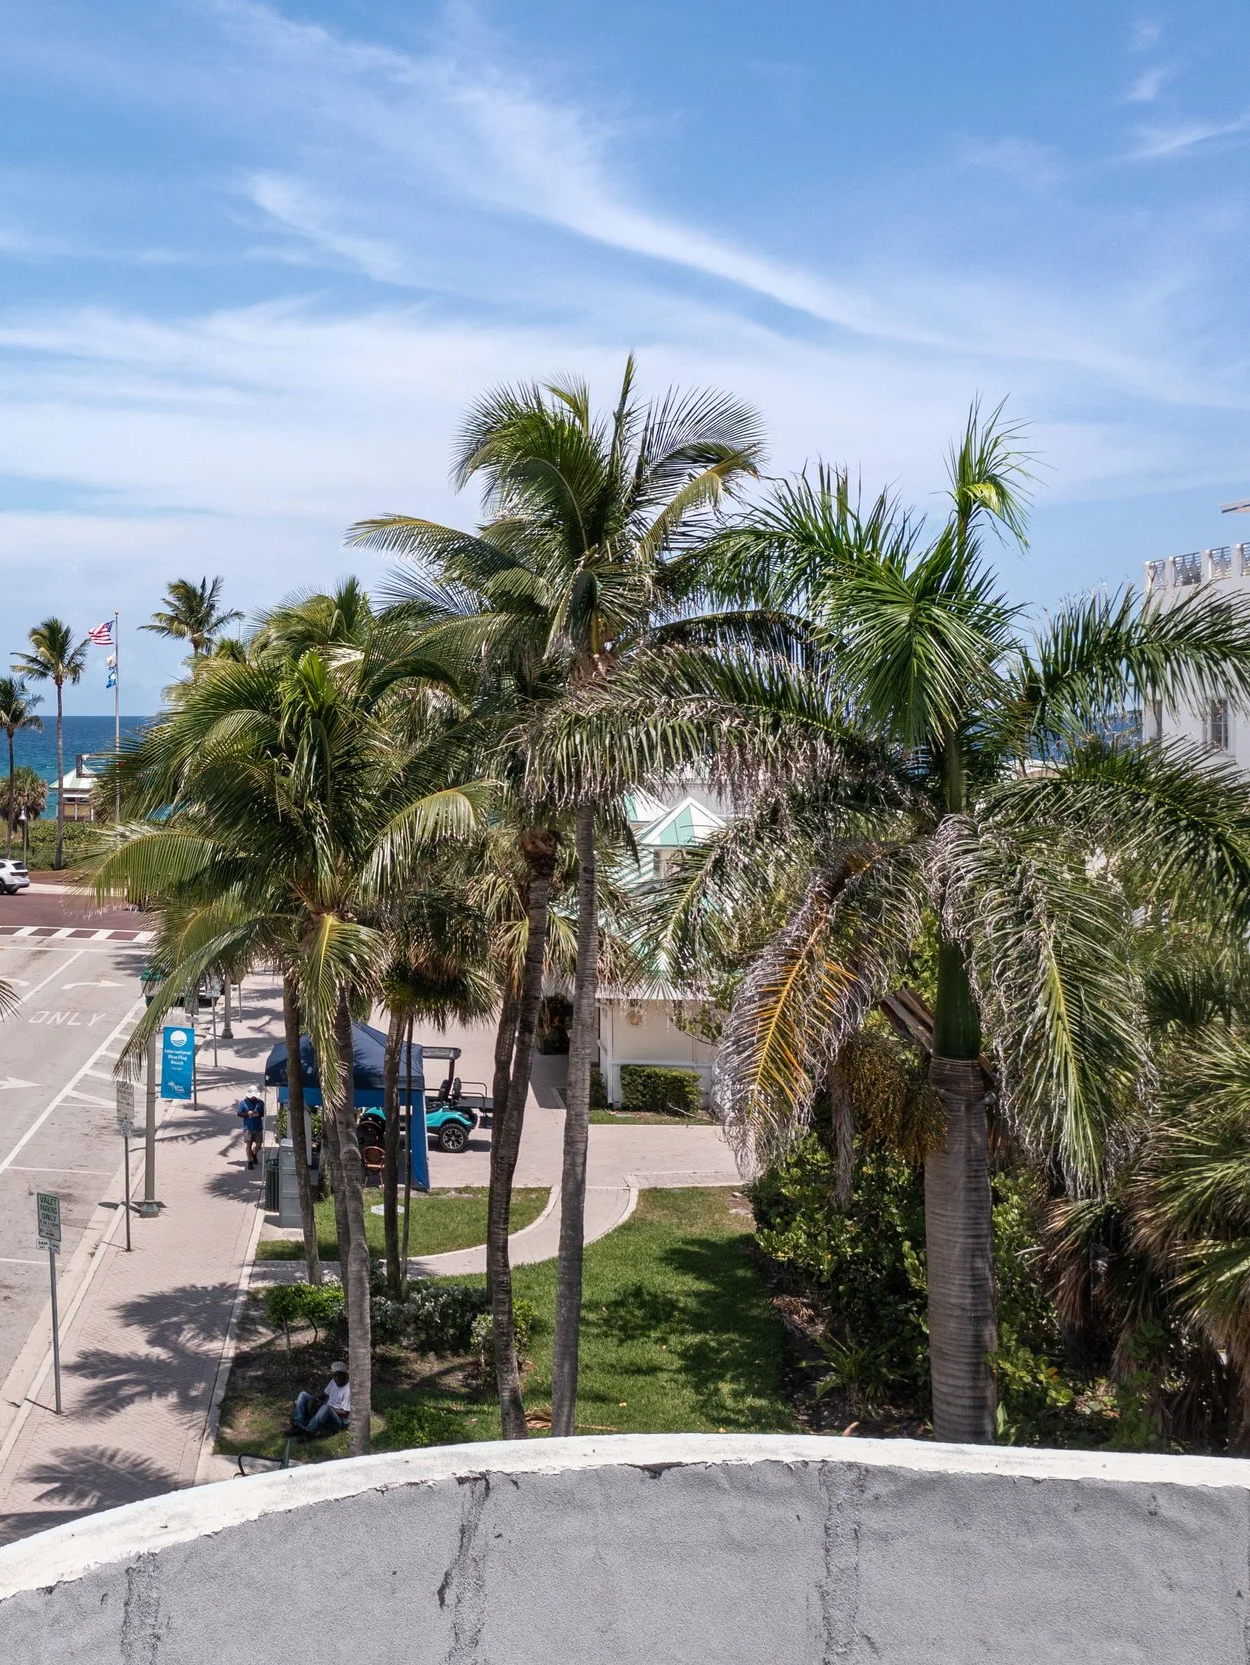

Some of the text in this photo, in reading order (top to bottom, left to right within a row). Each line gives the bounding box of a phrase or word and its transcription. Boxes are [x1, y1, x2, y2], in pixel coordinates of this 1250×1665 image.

[28, 1011, 107, 1027] ONLY
[40, 1195, 57, 1206] VALET
[41, 1212, 57, 1222] ONLY
